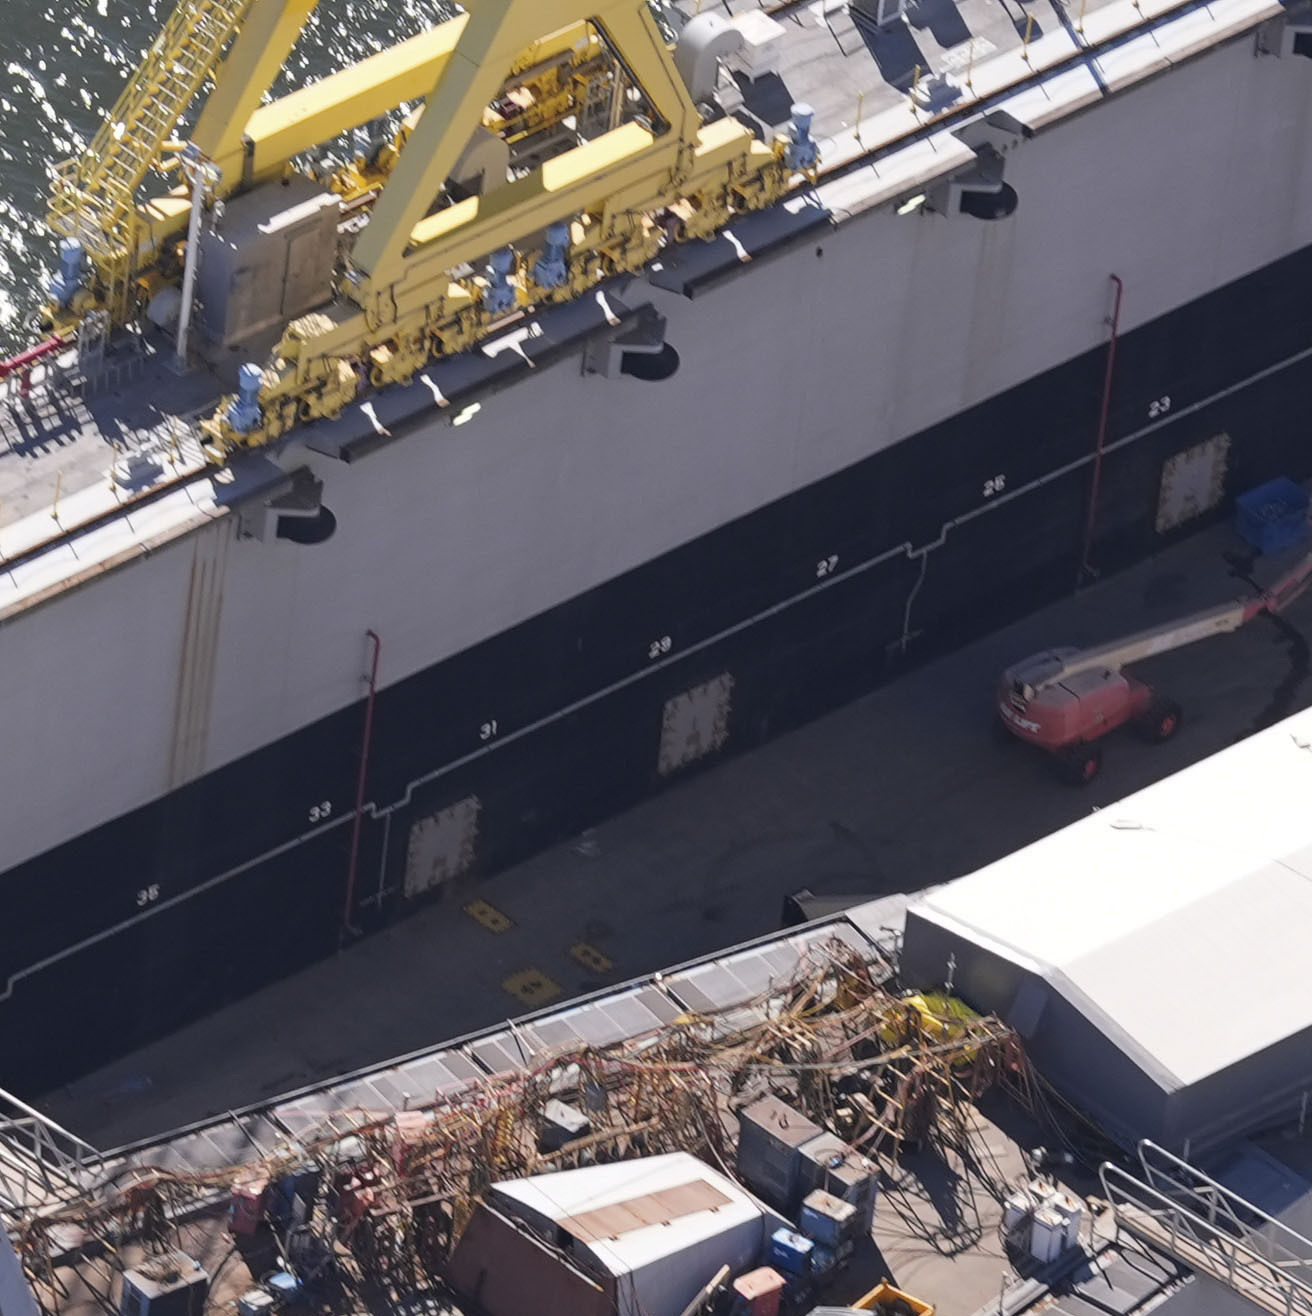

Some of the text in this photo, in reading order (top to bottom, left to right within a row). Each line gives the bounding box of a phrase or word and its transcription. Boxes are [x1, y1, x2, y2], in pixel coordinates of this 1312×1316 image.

[1148, 396, 1171, 418] 23
[982, 474, 1005, 497] 25
[816, 555, 839, 578] 27
[649, 636, 672, 659] 29
[478, 719, 497, 740] 31
[309, 800, 332, 823] 33
[136, 884, 160, 907] 35
